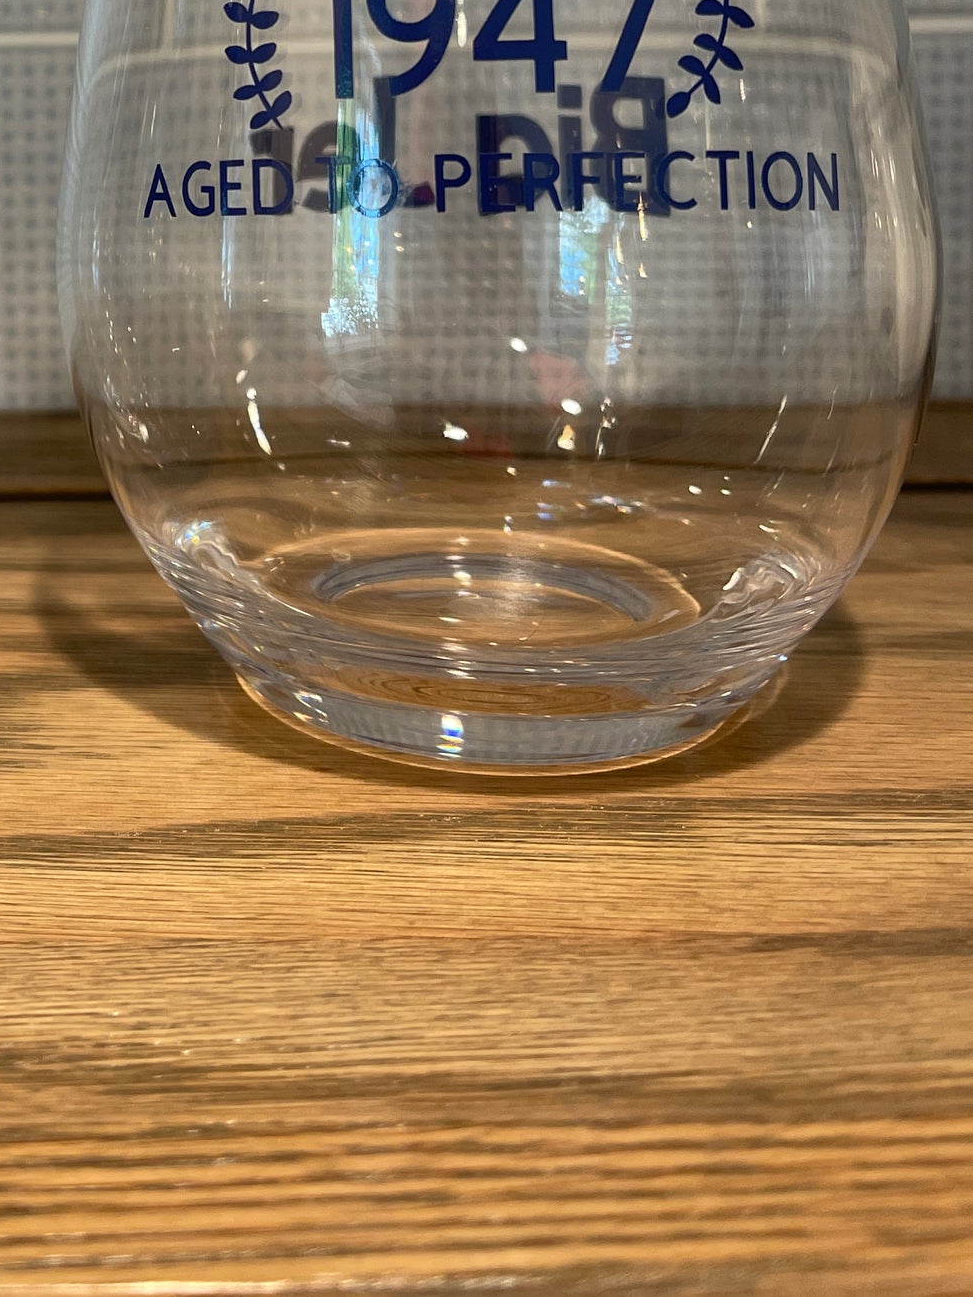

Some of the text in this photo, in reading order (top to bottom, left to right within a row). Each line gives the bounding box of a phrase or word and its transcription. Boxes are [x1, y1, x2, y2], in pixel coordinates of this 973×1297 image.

[143, 151, 841, 219] AGED TO PERFECTION
